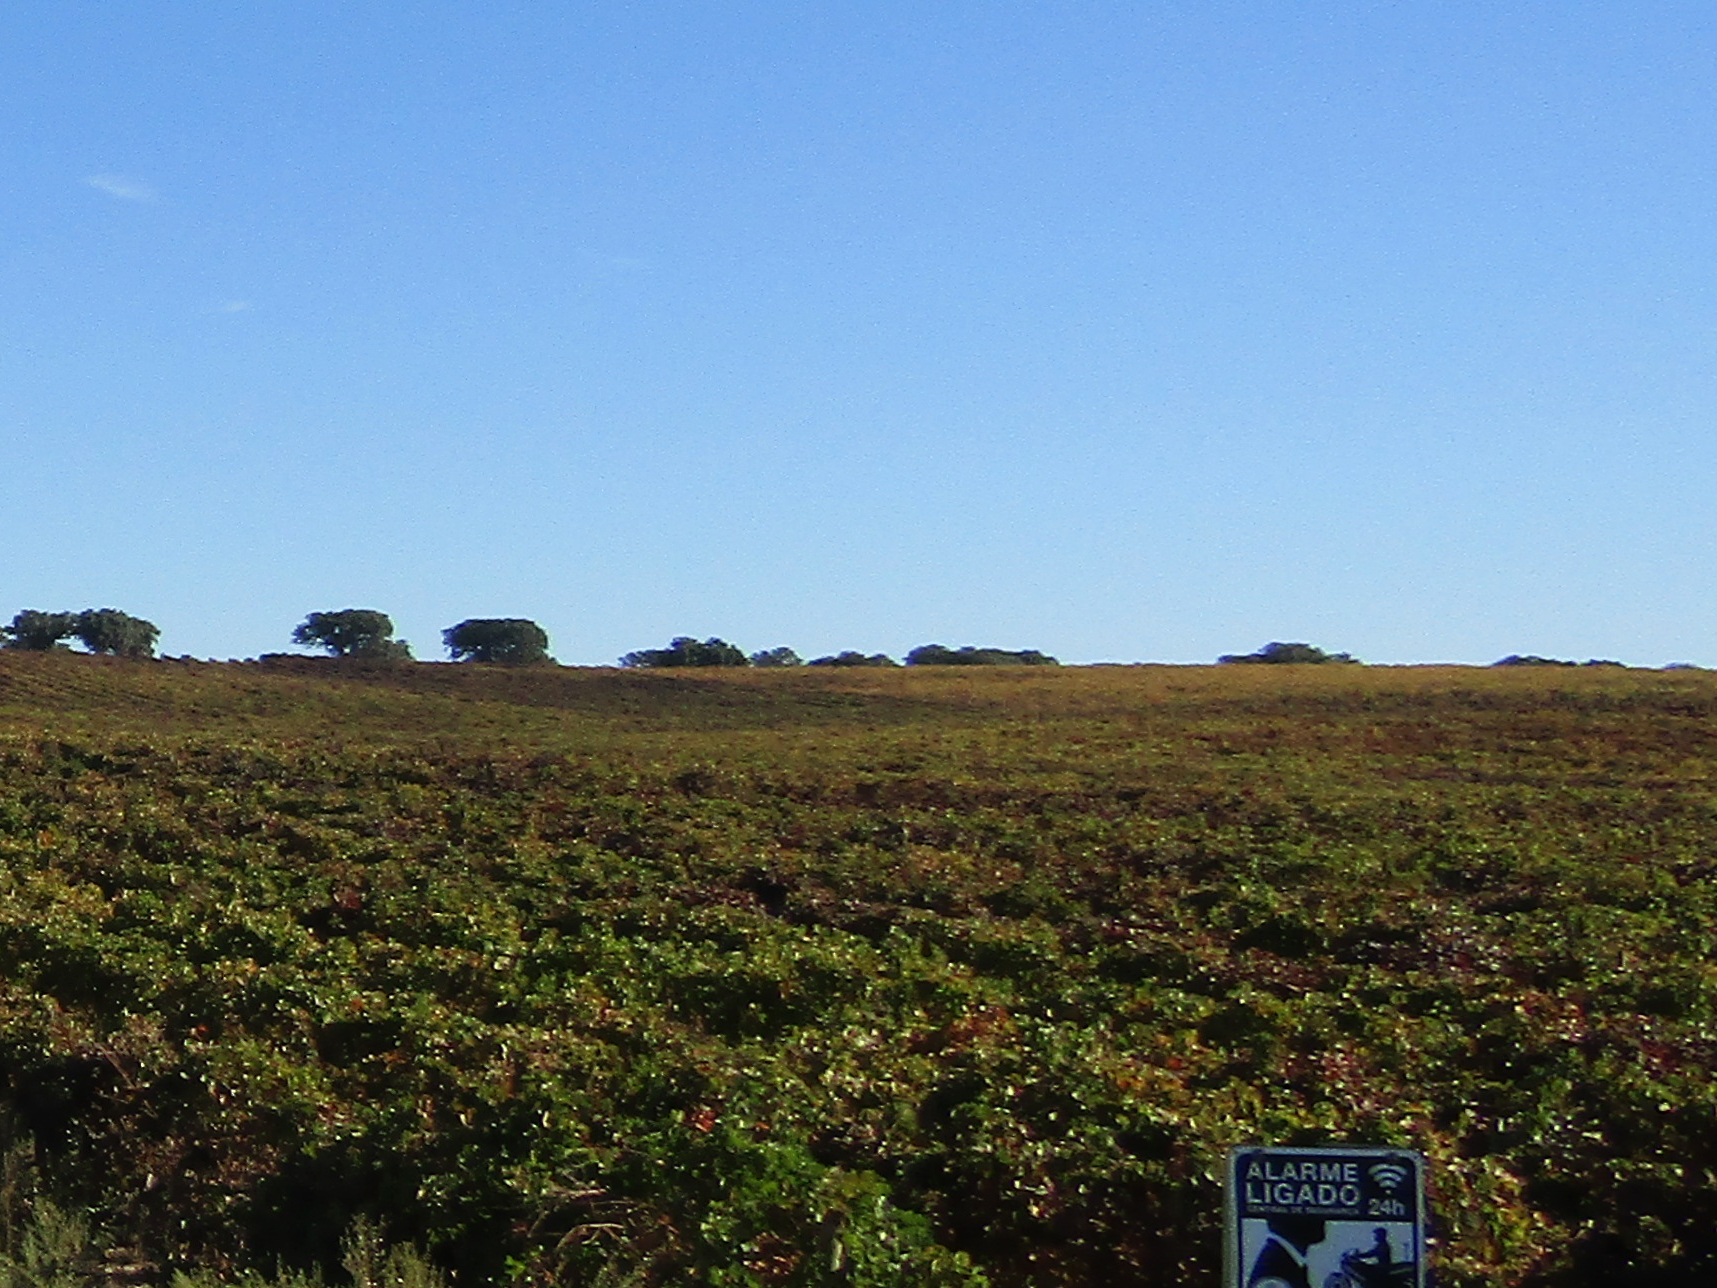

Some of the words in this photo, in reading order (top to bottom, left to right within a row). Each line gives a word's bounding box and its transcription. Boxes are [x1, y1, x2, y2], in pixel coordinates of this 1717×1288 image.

[1246, 1161, 1358, 1182] ALARME
[1246, 1182, 1360, 1206] LIGADO
[1368, 1198, 1406, 1216] 24h
